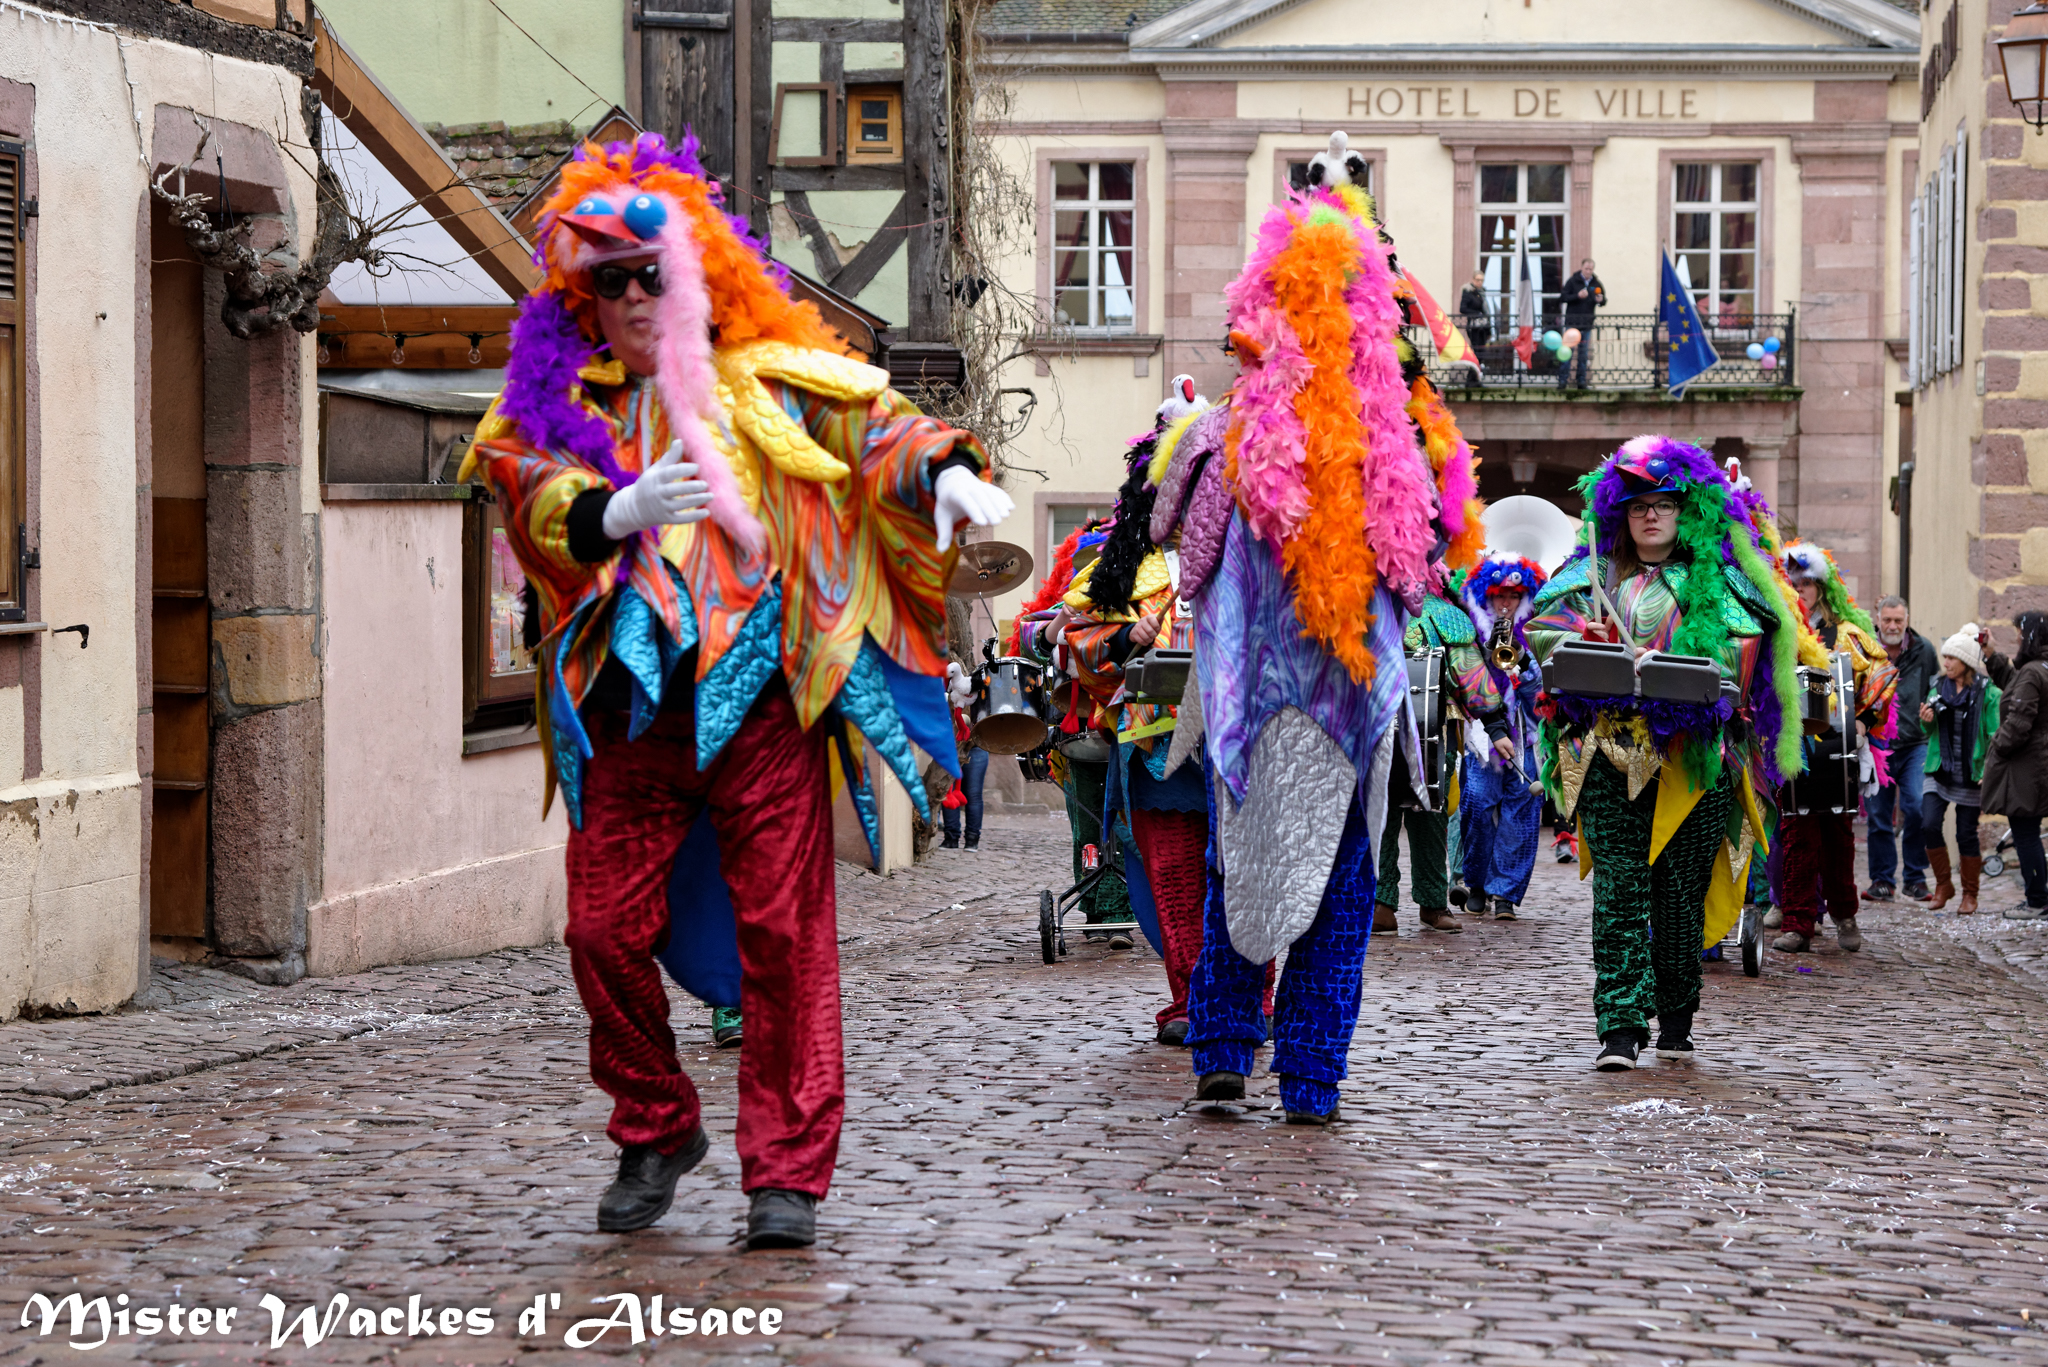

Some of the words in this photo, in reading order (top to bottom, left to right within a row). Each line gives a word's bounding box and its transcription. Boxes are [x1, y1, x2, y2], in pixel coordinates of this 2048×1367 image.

[1347, 86, 1480, 117] HOTEL
[1513, 87, 1562, 118] DE
[1594, 88, 1699, 119] VILLE
